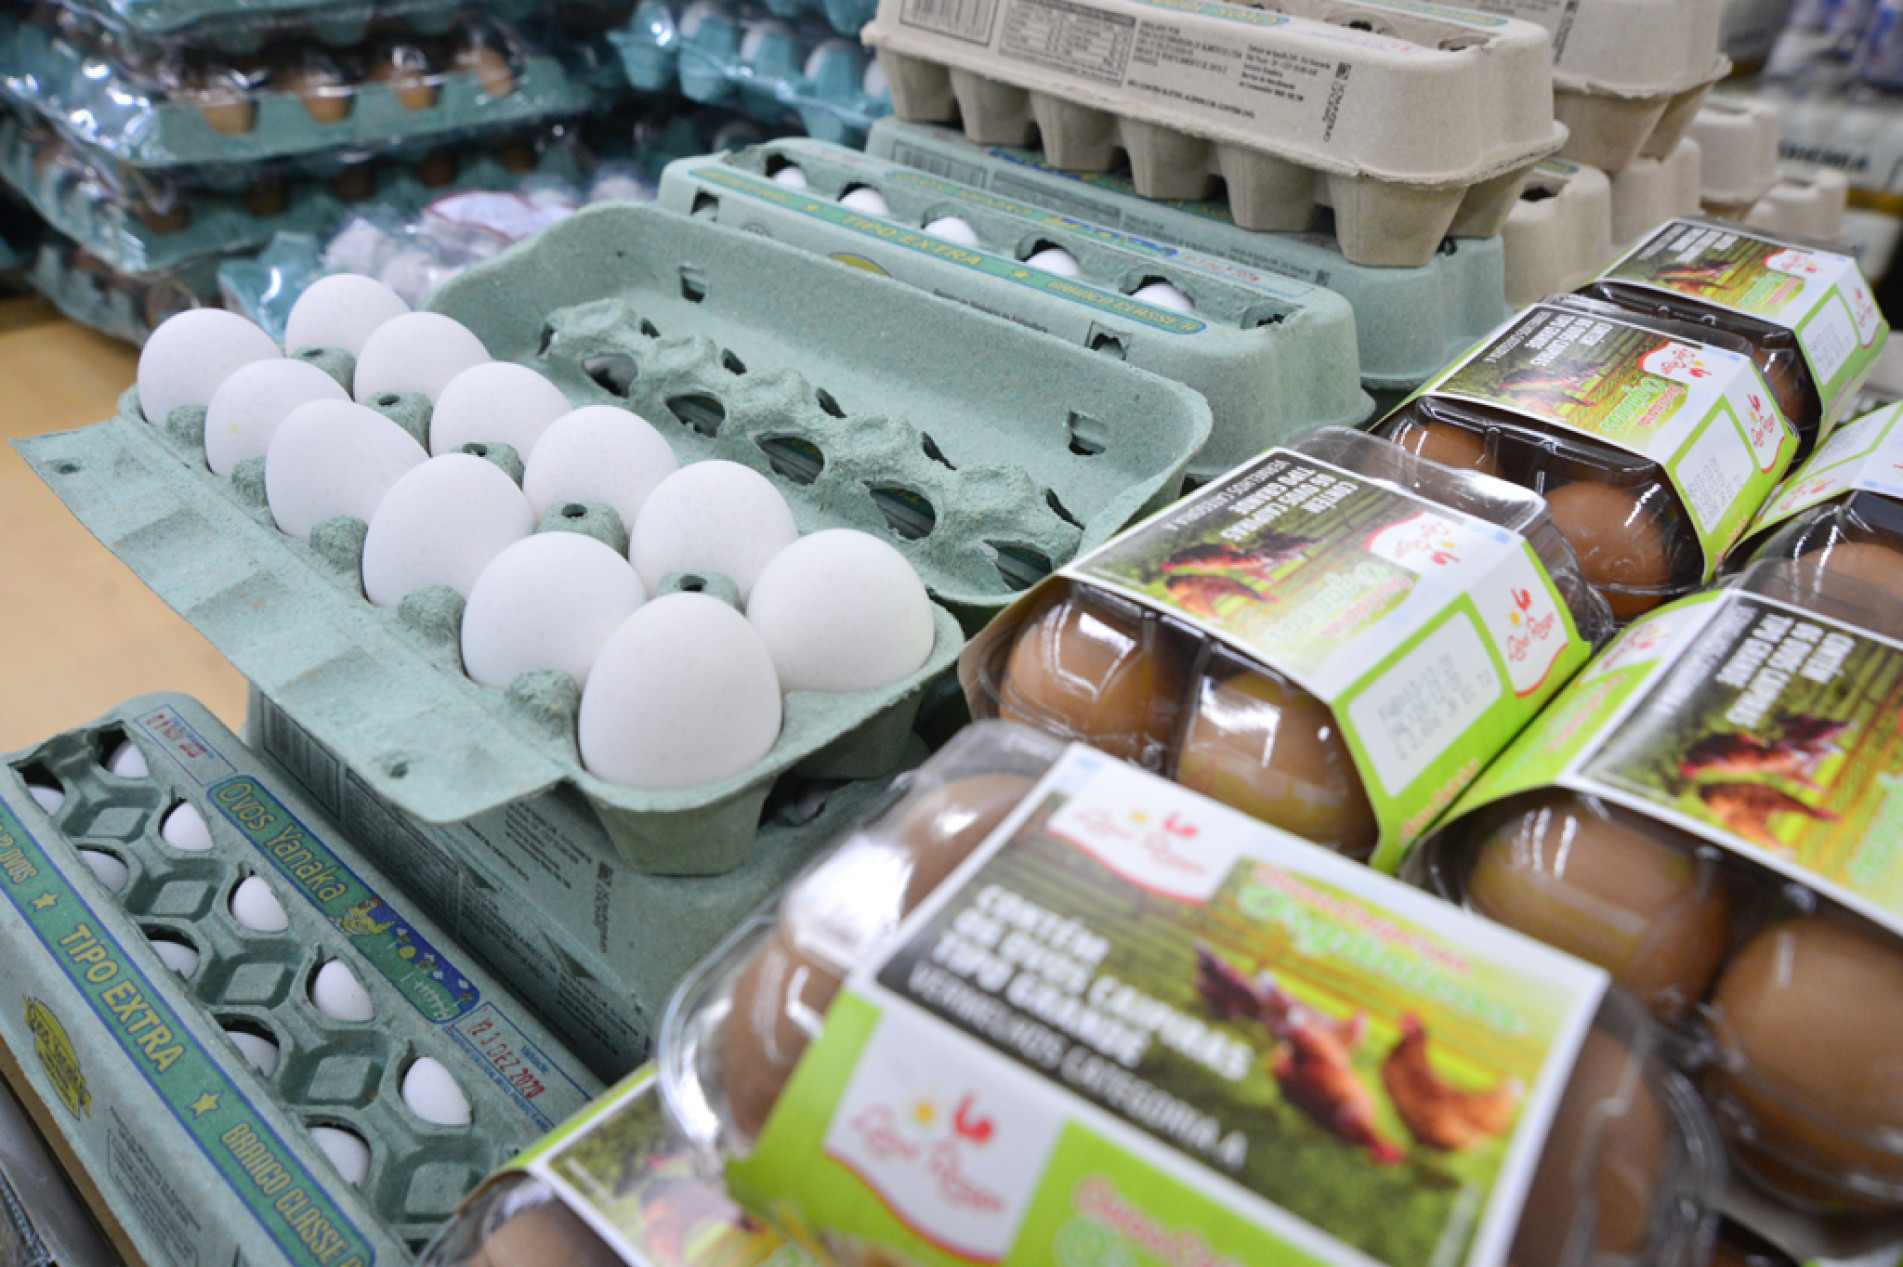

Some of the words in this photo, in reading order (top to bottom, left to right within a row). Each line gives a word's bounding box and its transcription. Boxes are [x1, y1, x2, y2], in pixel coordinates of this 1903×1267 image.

[217, 782, 276, 833] Ovos
[262, 824, 348, 904] Yanaka
[975, 883, 1110, 966] CONTÉM
[58, 921, 119, 985] TIPO
[101, 980, 185, 1074] EXTRA
[931, 928, 1016, 993] TIPO
[1004, 970, 1151, 1068] GRANDE
[1088, 973, 1255, 1083] CAIPIRAS
[1058, 1045, 1221, 1149] CATEGORIA
[221, 1121, 292, 1196] BRANCO
[275, 1187, 349, 1266] CLASSE
